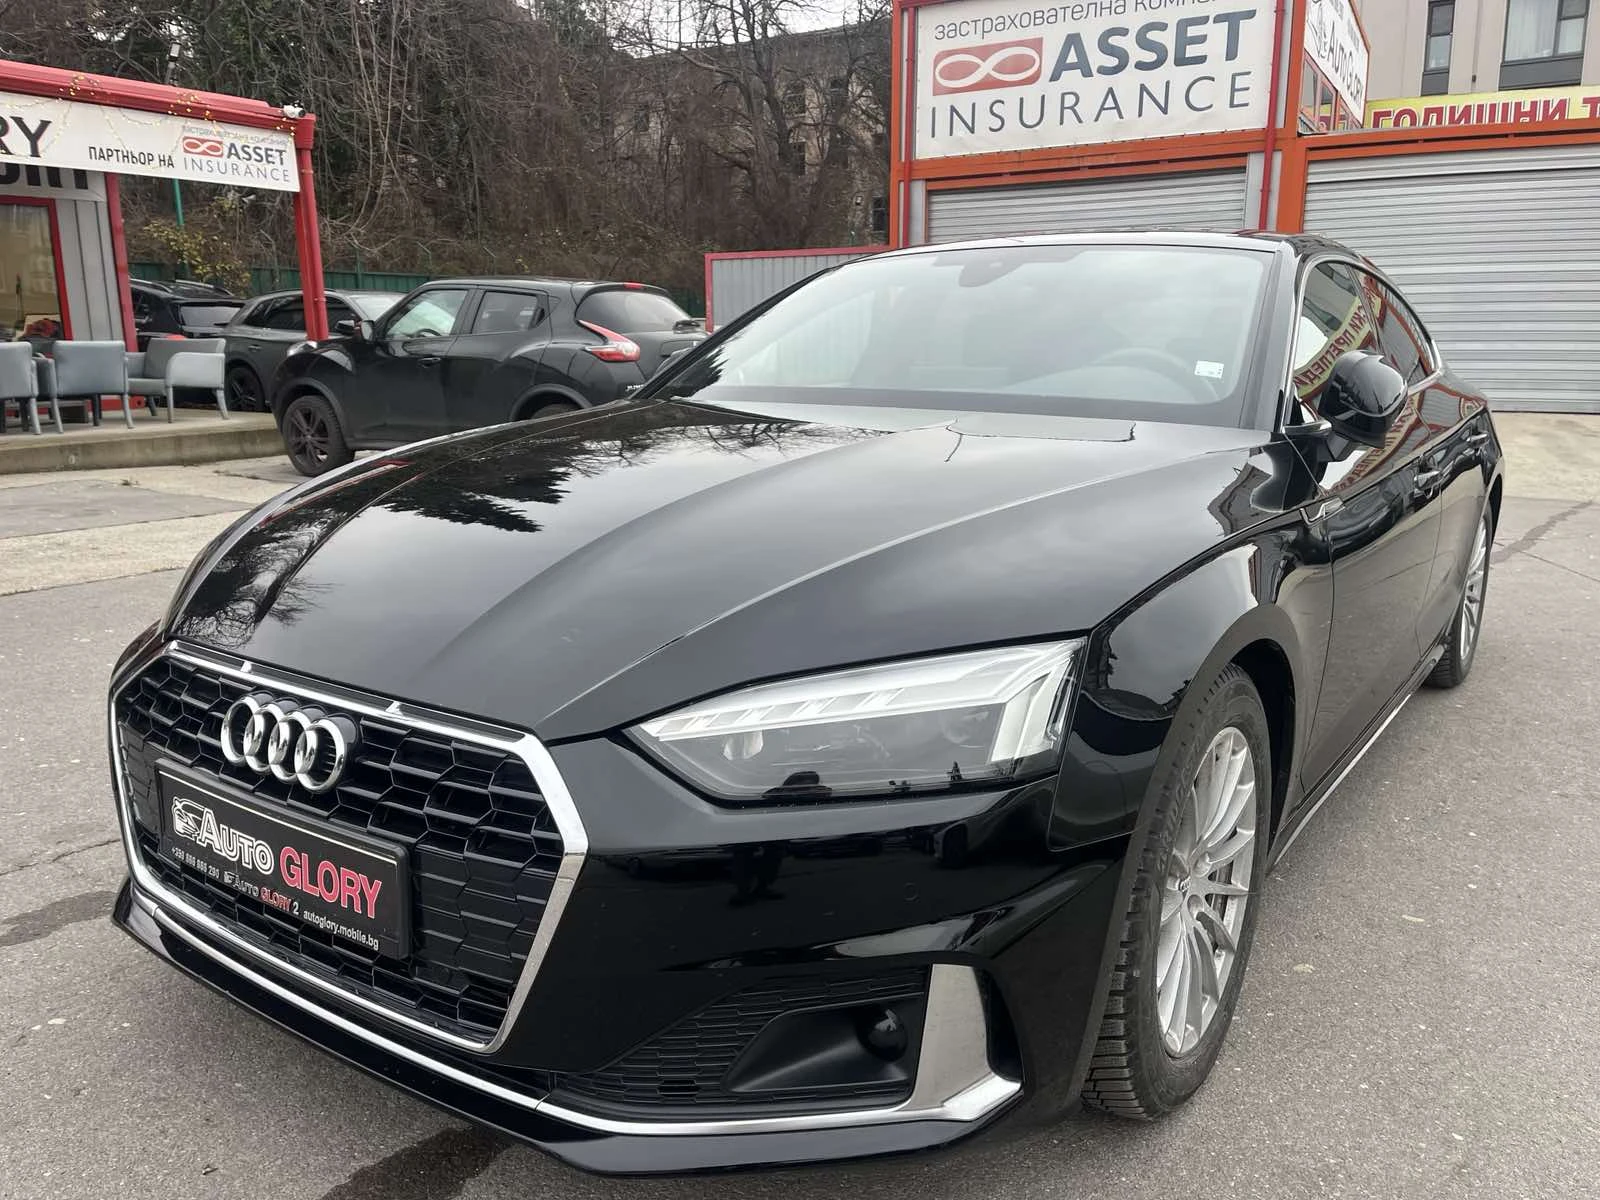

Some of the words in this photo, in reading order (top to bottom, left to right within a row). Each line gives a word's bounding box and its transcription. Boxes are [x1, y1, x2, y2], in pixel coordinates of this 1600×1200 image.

[934, 0, 1127, 40] застрахователна
[1049, 9, 1257, 82] ASSET
[931, 71, 1252, 138] INSURANCE
[88, 146, 154, 167] ПАРТНЬОР
[158, 154, 175, 168] НА
[184, 157, 290, 182] INSURANCE
[227, 142, 287, 166] ASSET
[280, 846, 382, 919] GLORY
[260, 887, 292, 912] GLORY
[293, 901, 300, 915] 2
[303, 910, 379, 951] autoglory.mobile.bg
